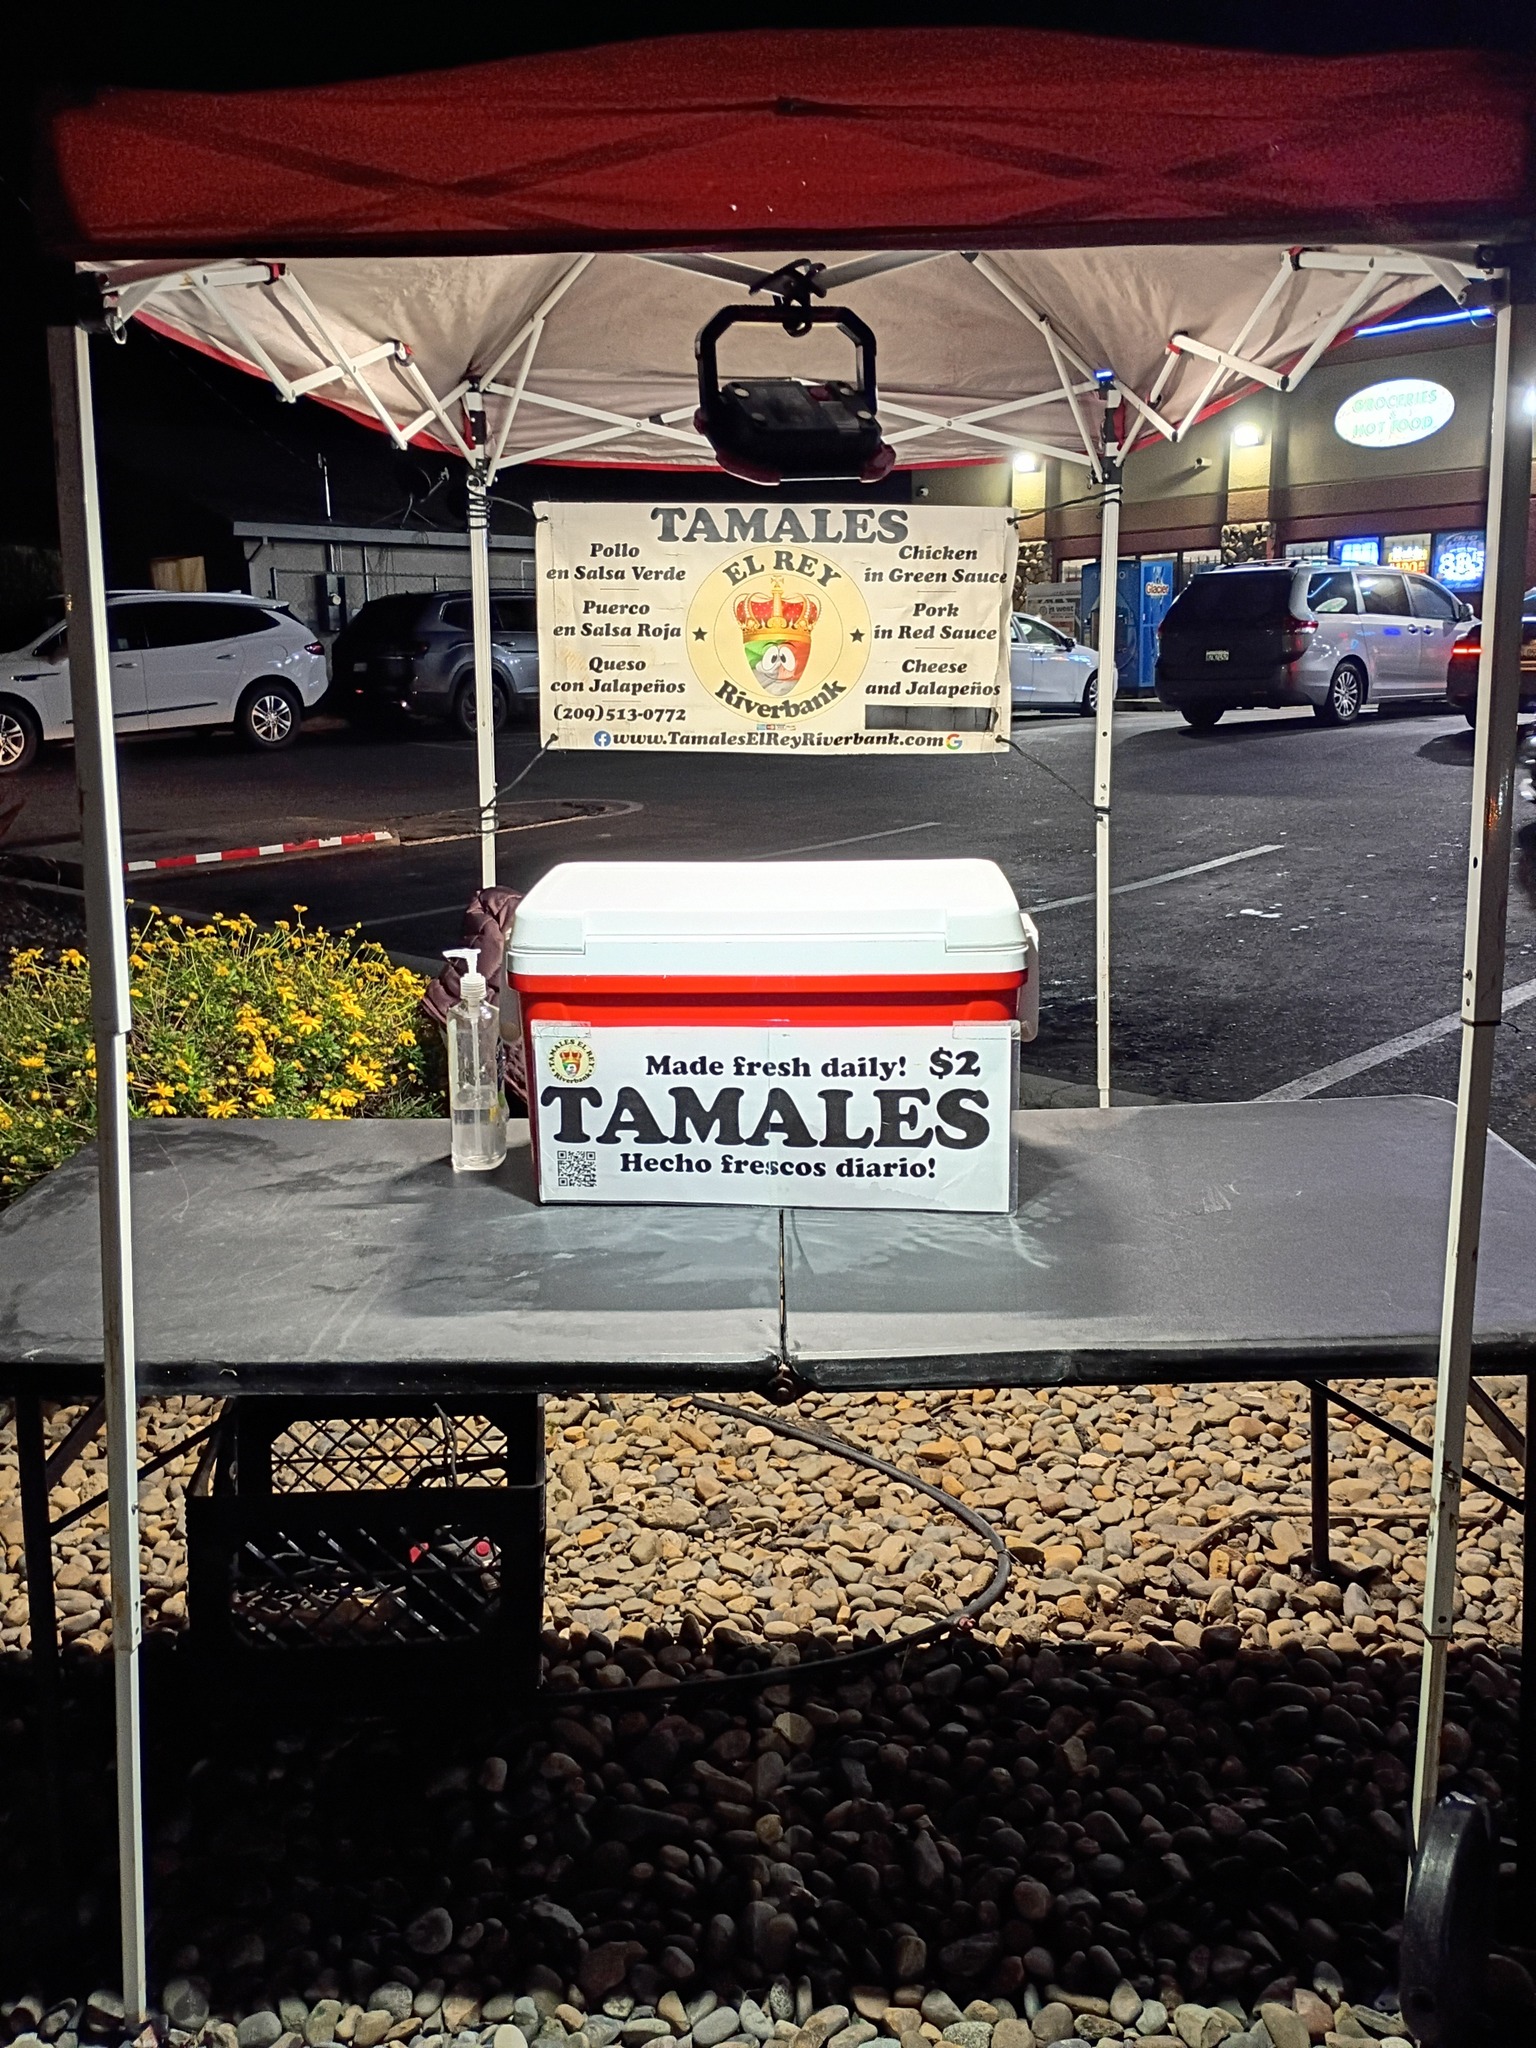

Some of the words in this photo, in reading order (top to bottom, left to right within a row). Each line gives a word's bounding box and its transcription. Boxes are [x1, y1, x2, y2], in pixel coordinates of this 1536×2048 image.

[1352, 389, 1438, 413] GROCERIES
[1352, 421, 1386, 438] HOT
[1391, 415, 1434, 433] FOOD
[650, 507, 909, 544] TAMALES
[590, 543, 640, 558] Pollo
[898, 545, 978, 561] Chicken
[546, 569, 569, 580] en
[574, 566, 626, 580] Salsa
[631, 566, 687, 581] Verde
[722, 555, 766, 587] EL
[773, 550, 842, 588] REY
[864, 568, 883, 583] in
[888, 568, 947, 583] Green
[951, 569, 1008, 584] Sauce
[1145, 583, 1170, 595] Glacier
[582, 600, 650, 615] Puerco
[912, 603, 960, 617] Pork
[553, 625, 576, 637] en
[580, 623, 632, 637] Salsa
[636, 623, 682, 640] Roja
[874, 625, 893, 639] in
[897, 625, 935, 640] Red
[939, 625, 998, 640] Sauce
[588, 656, 647, 673] Queso
[901, 659, 968, 673] Cheese
[550, 681, 585, 692] con
[588, 679, 687, 696] Jalapeños
[865, 681, 902, 695] and
[905, 681, 1002, 698] Jalapeños
[714, 679, 848, 720] Riverbank
[553, 704, 687, 722] (209)513-0772
[612, 731, 944, 749] www.TamalesElReyRiverbank.com
[549, 1039, 575, 1067] TAMALES
[586, 1051, 595, 1068] REY
[645, 1055, 724, 1076] Made
[732, 1056, 812, 1077] fresh
[820, 1056, 907, 1081] daily!
[929, 1046, 981, 1079] $2
[554, 1072, 591, 1083] Riverbank
[540, 1085, 991, 1150] TAMALES
[620, 1153, 712, 1173] Hecho
[721, 1154, 827, 1177] frescos
[835, 1157, 936, 1179] diario!
